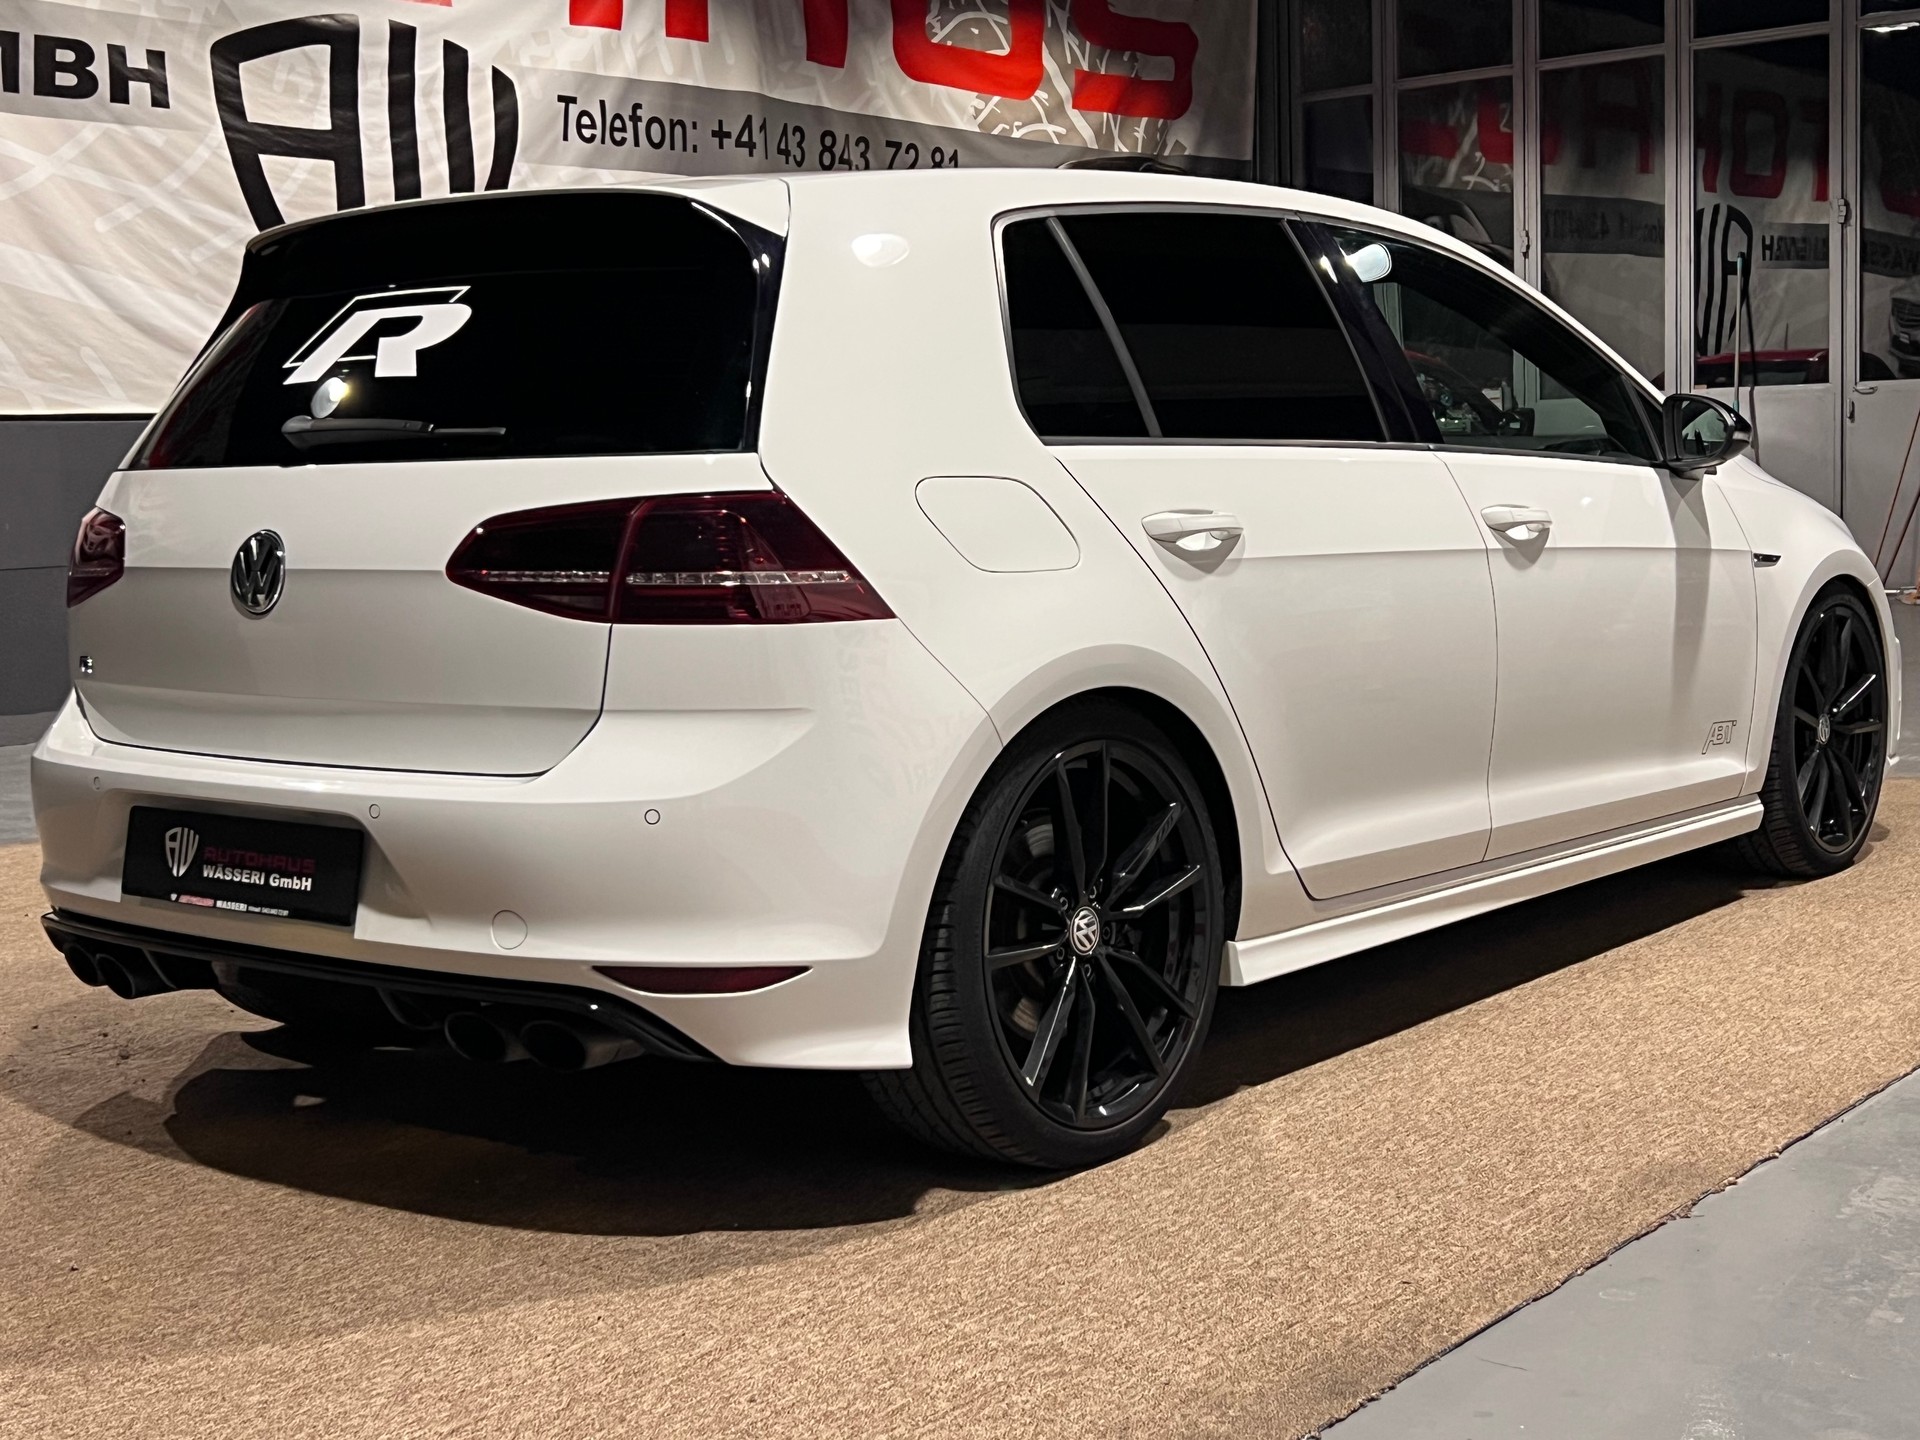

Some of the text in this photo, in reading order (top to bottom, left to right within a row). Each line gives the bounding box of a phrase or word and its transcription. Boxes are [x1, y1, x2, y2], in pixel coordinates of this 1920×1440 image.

[557, 94, 698, 153] Telefon:
[818, 130, 871, 171] 843
[885, 140, 919, 170] 72
[282, 285, 472, 385] R
[1701, 719, 1738, 755] ABT
[202, 863, 312, 892] WÄSSERI GmbH
[203, 846, 316, 874] AUTOHAUS
